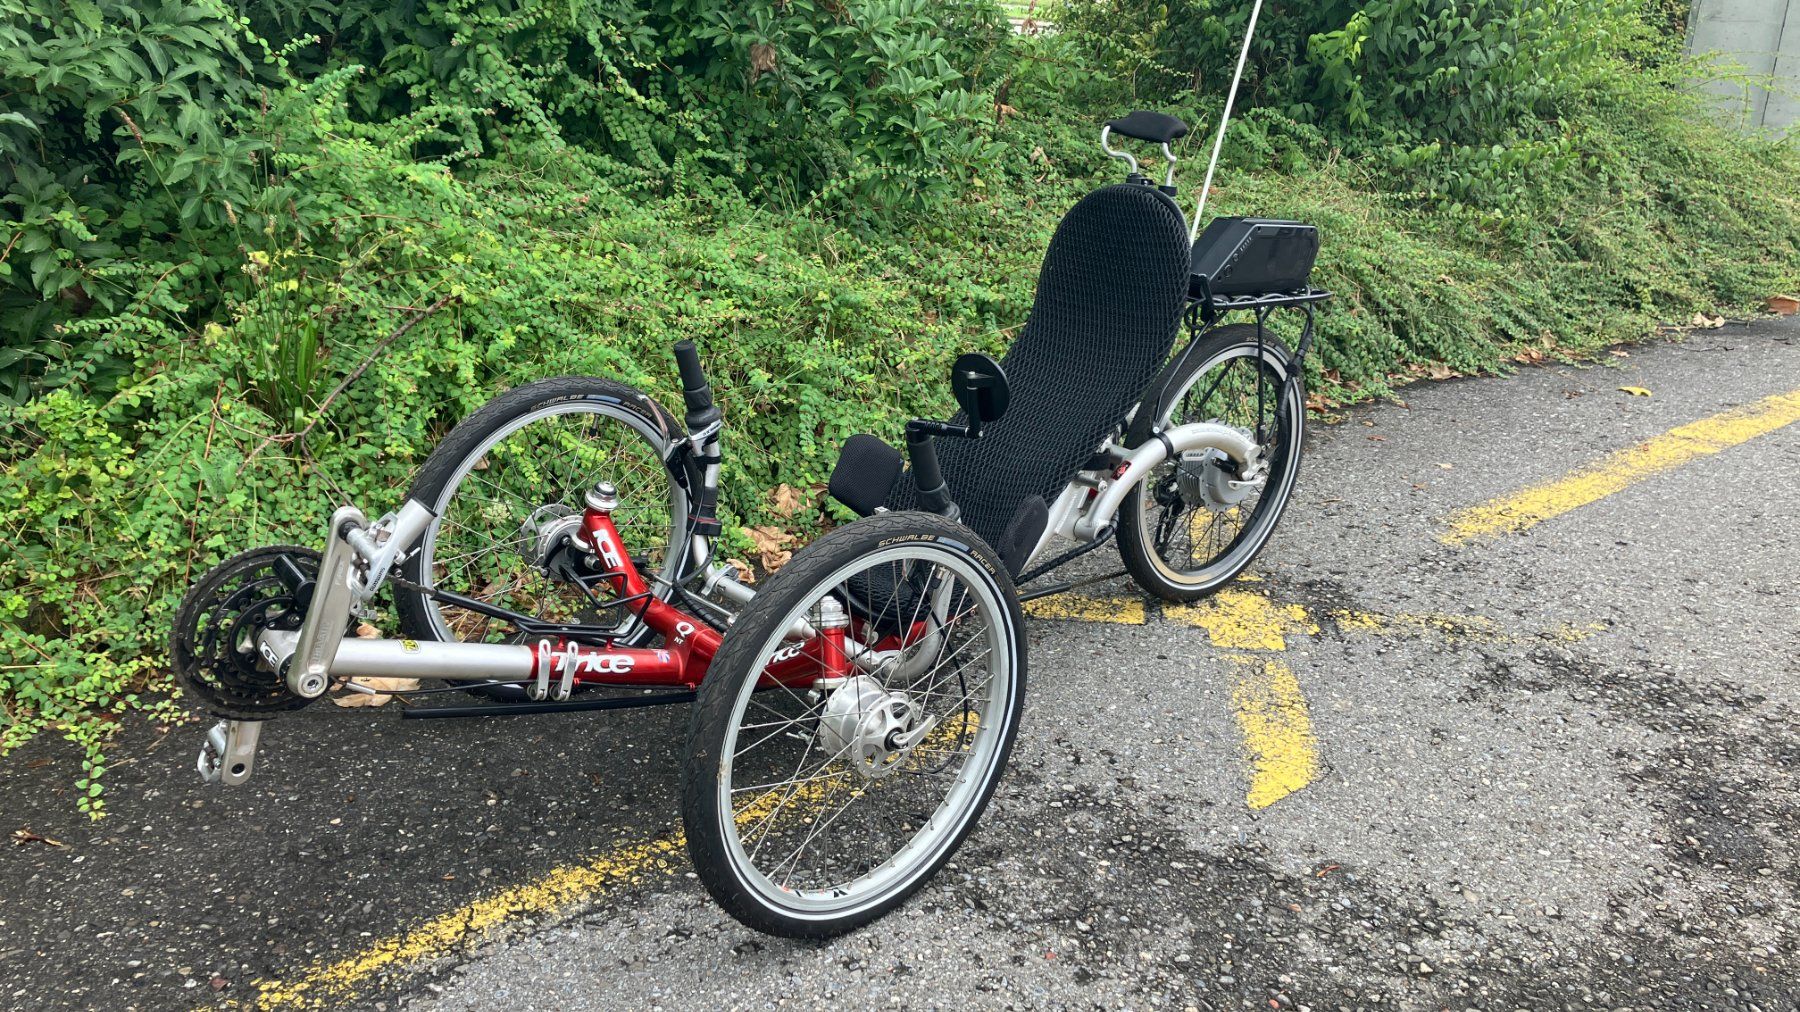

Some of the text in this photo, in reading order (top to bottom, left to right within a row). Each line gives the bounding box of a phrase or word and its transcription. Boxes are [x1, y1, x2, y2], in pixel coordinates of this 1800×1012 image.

[878, 534, 996, 575] SCHWALBE RACER
[260, 640, 279, 667] ICE
